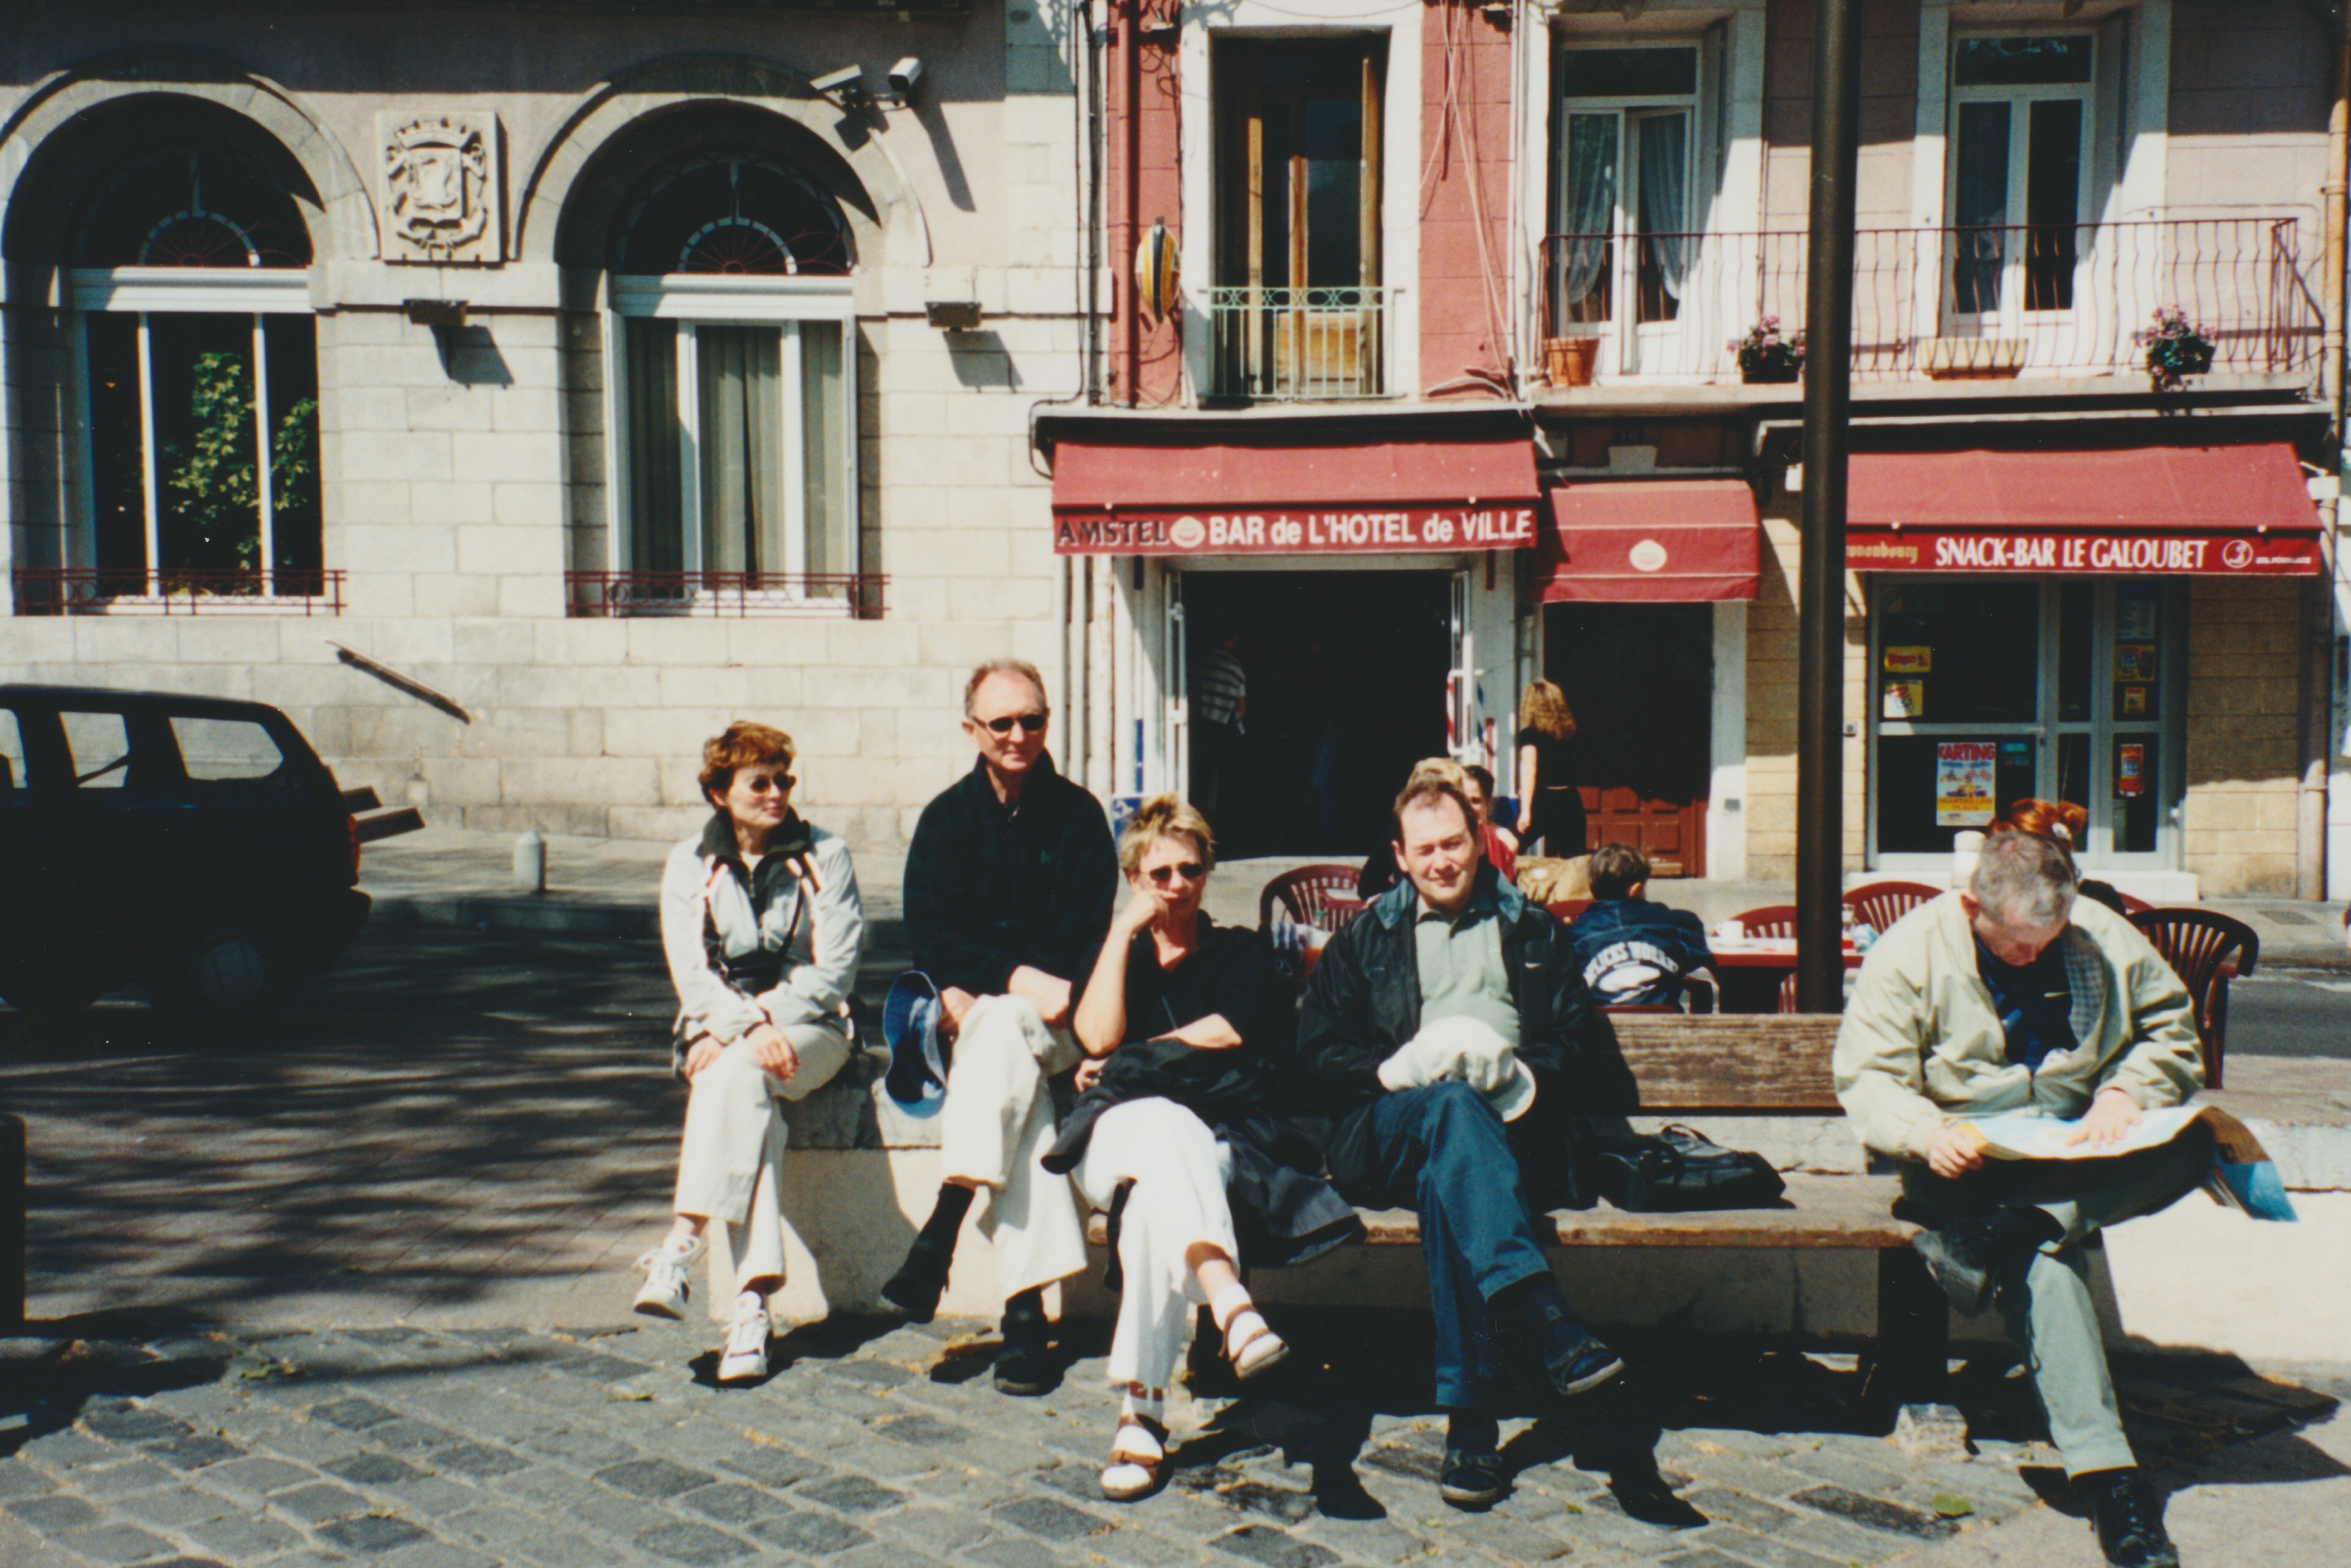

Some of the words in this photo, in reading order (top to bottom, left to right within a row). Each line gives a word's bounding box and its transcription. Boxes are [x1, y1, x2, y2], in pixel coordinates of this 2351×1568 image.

[1059, 520, 1171, 547] AMSTEL
[1209, 516, 1264, 545] BAR
[1270, 516, 1302, 545] de
[1309, 513, 1417, 543] L'HOTEL
[1422, 512, 1454, 543] de
[1460, 510, 1532, 541] VILLE
[1935, 537, 2056, 566] SNACK-BAR
[2062, 539, 2086, 567] LE
[2090, 539, 2208, 568] GALOUBET
[1937, 743, 1996, 760] KARTING
